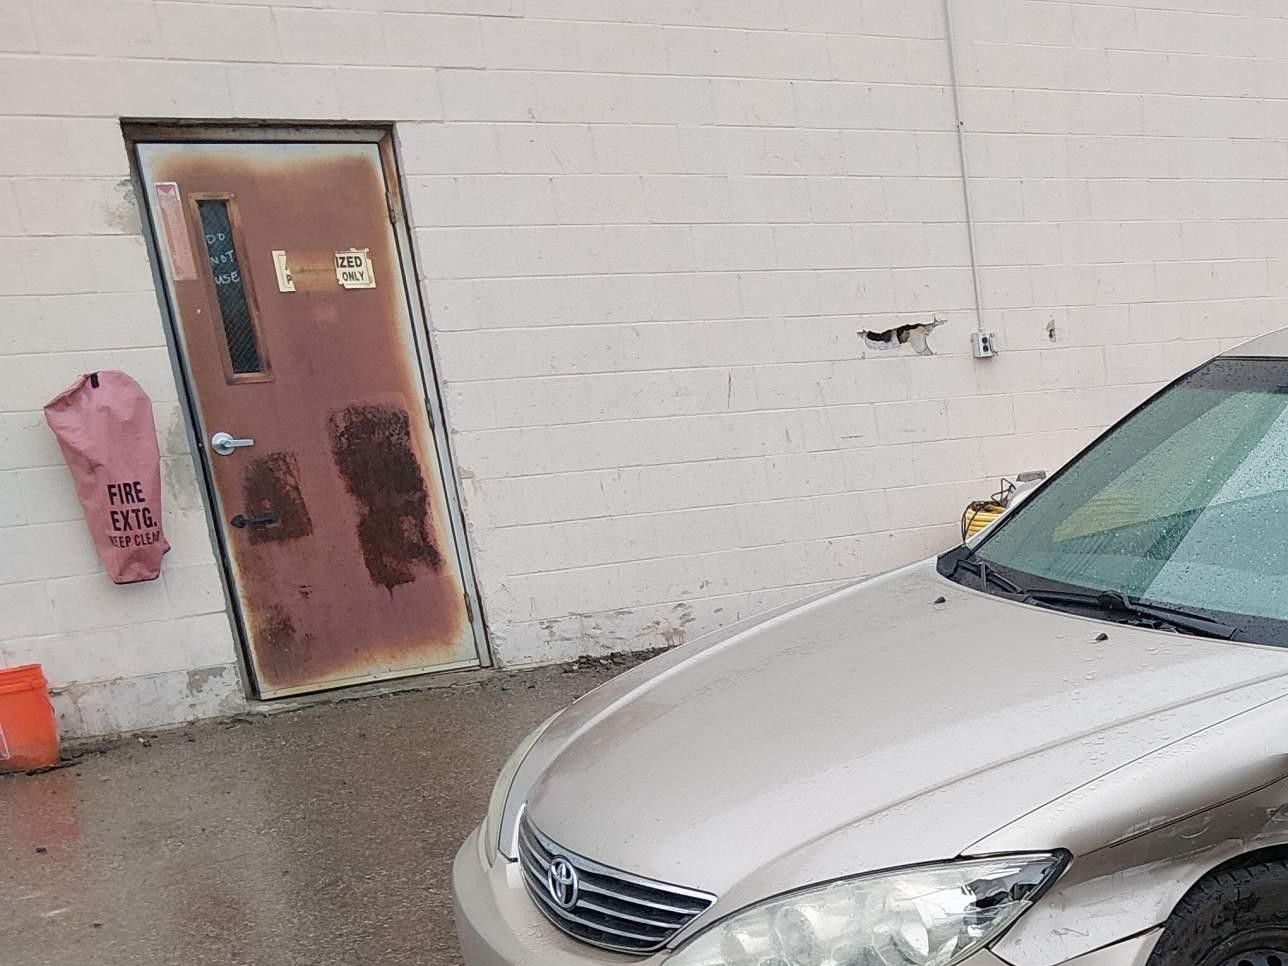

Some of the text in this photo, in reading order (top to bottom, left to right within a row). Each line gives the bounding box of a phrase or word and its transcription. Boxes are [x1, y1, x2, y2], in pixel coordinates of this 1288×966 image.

[205, 233, 225, 244] DO
[210, 249, 234, 265] NOT
[335, 255, 363, 269] IZED
[214, 270, 241, 285] USE
[341, 270, 365, 282] ONLY
[107, 481, 146, 506] FIRE
[110, 507, 158, 532] EXTG.
[133, 530, 161, 547] CLE
